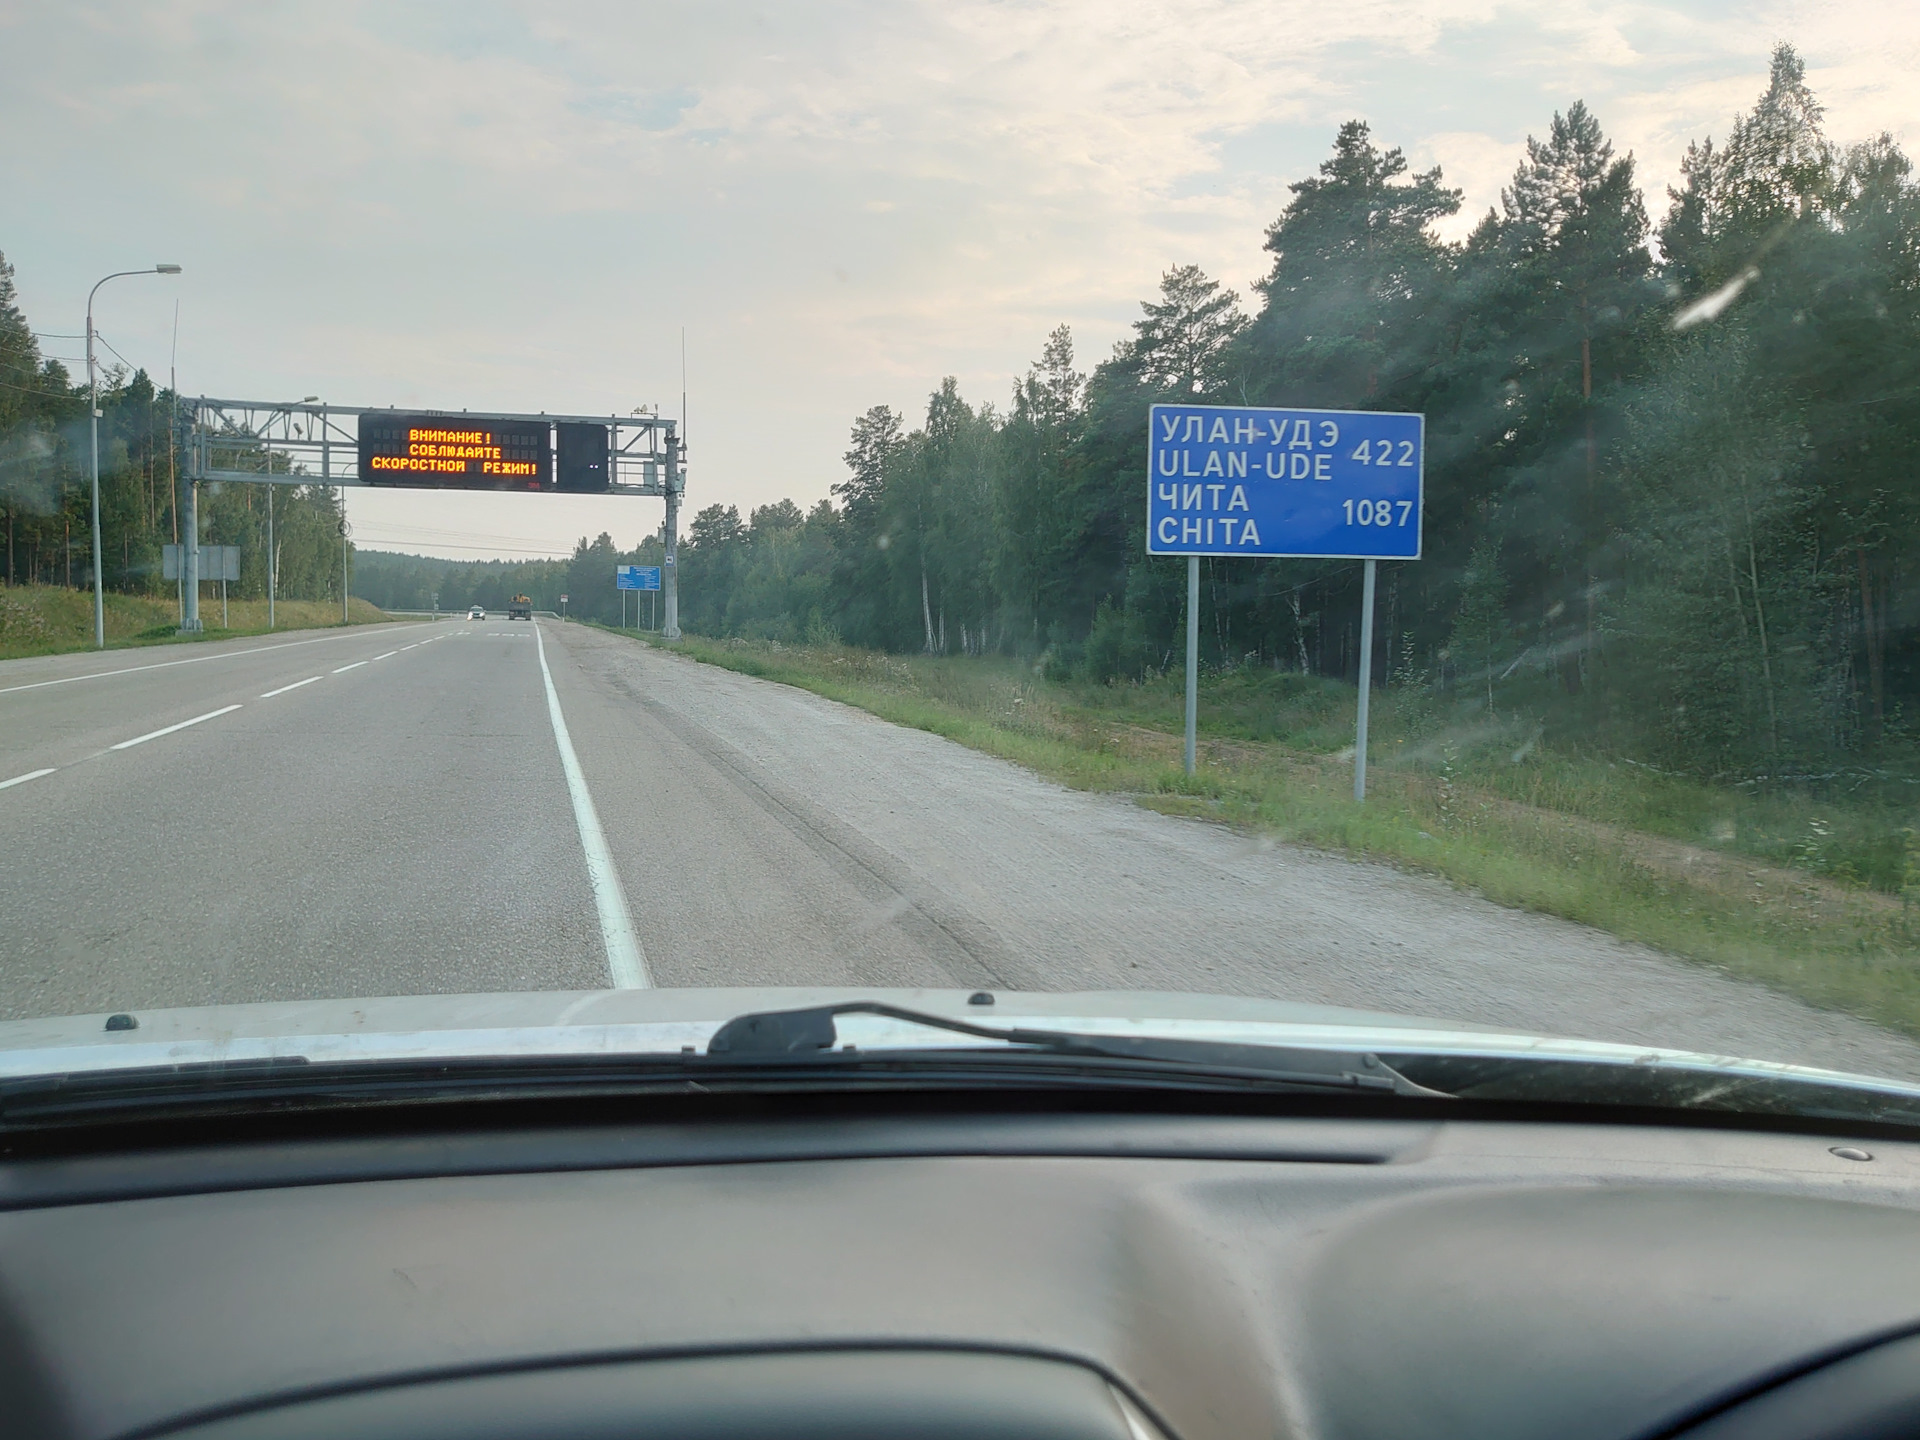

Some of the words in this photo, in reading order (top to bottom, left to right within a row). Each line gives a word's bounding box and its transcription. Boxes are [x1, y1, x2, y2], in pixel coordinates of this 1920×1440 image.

[409, 429, 491, 444] ВНИМАНИЕ!
[1161, 415, 1339, 450] УЛАН-УДЭ
[409, 444, 502, 459] СОБЛЮДАЙТЕ
[1159, 450, 1333, 480] ULAN-UDE
[1351, 440, 1414, 467] 422
[371, 456, 466, 472] СКОРОСТНОЙ
[482, 461, 537, 475] РЕЖИМ!
[1159, 484, 1249, 511] ЧИТА
[1342, 499, 1412, 527] 1087
[1158, 517, 1261, 546] CHITA
